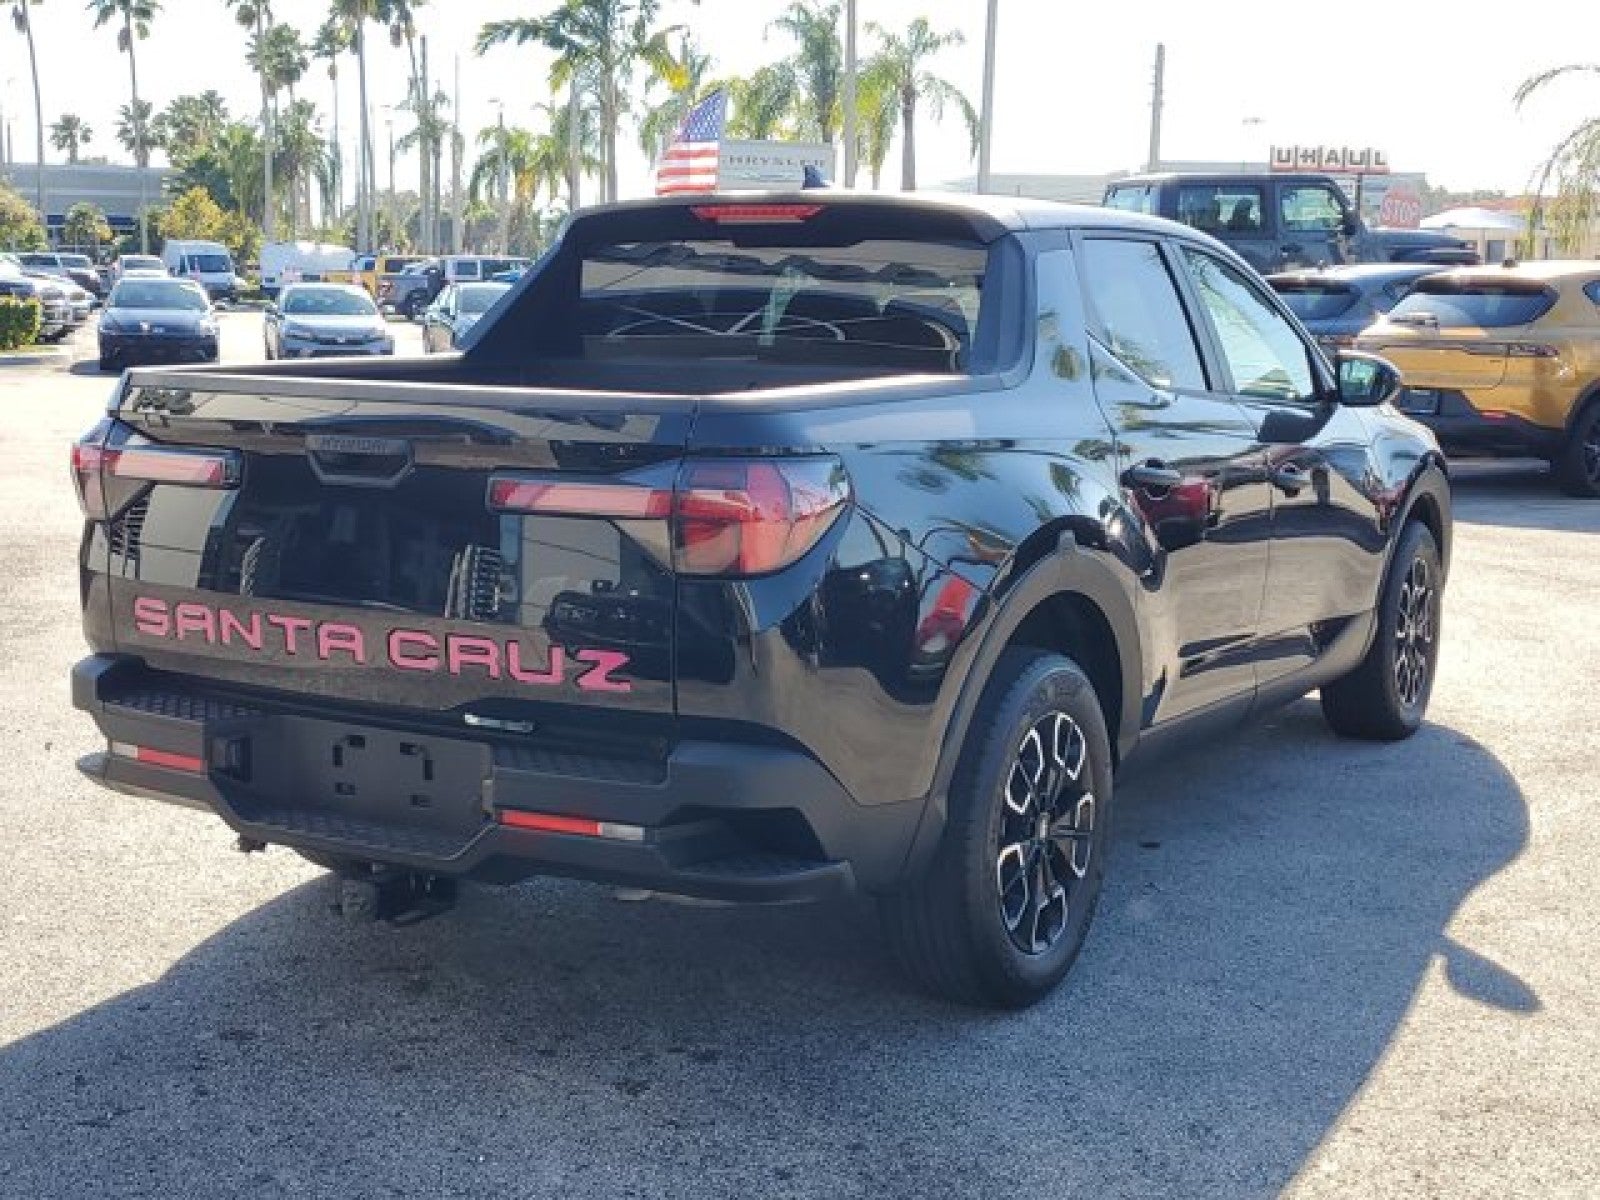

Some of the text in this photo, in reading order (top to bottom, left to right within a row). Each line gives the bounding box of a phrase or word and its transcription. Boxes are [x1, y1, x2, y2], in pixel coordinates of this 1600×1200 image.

[1382, 199, 1420, 223] STOP
[134, 597, 631, 691] SANTA CRUZ
